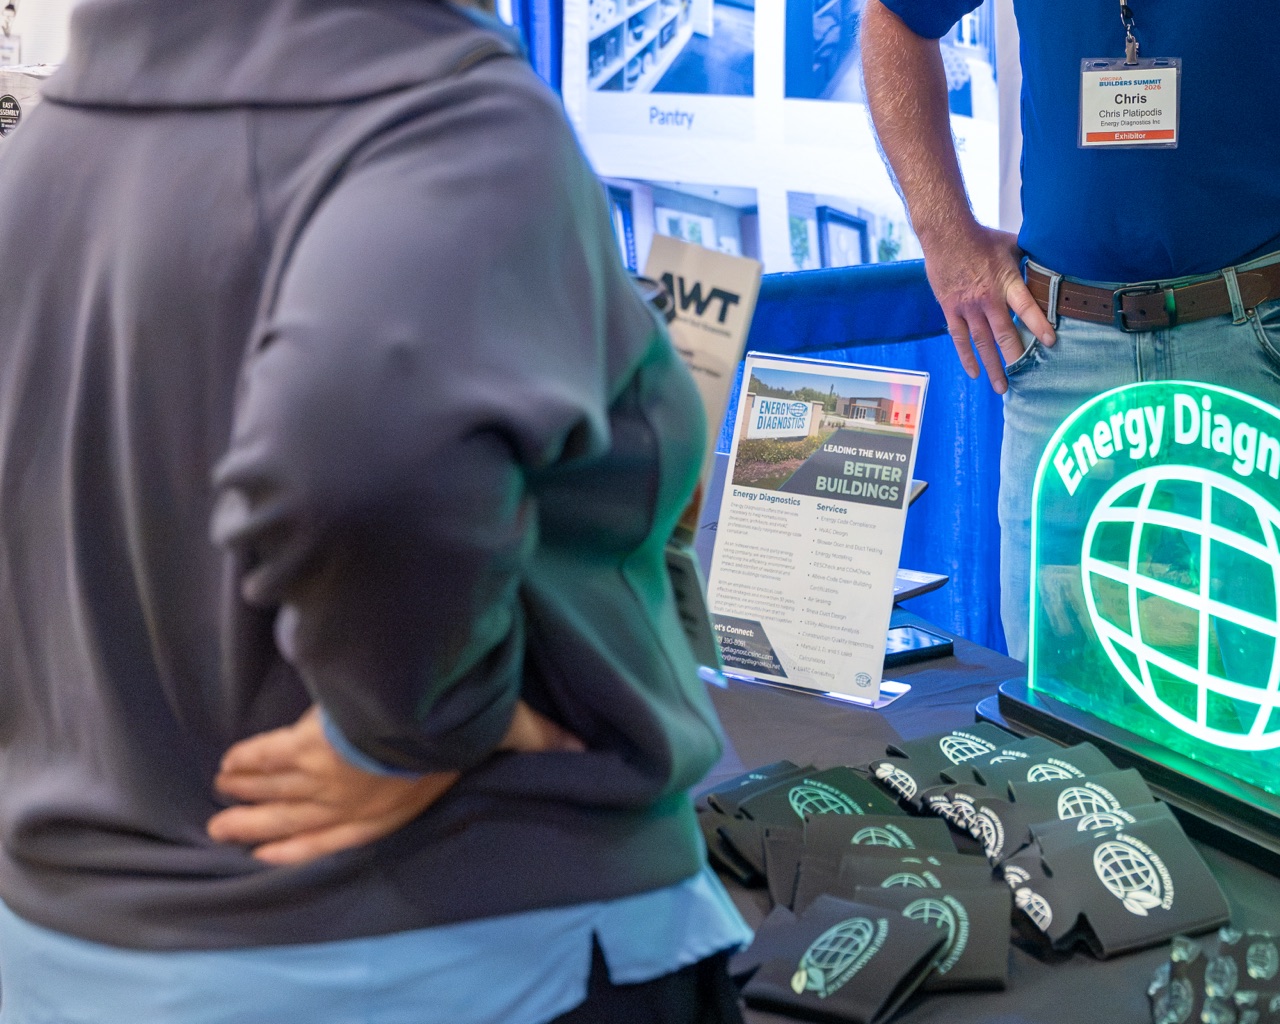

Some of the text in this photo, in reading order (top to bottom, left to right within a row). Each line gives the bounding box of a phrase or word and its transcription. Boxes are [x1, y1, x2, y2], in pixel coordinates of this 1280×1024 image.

[1114, 93, 1147, 104] Chris
[648, 106, 695, 130] Pantry
[1098, 109, 1120, 118] Chris
[1120, 119, 1151, 127] Diagnostics
[1114, 132, 1146, 140] Exhibitor
[759, 400, 790, 415] ENERGY
[757, 415, 806, 430] DIAGNOSTICS
[823, 443, 907, 463] LEADING THE WAY TO
[1053, 404, 1165, 496] Energy
[843, 460, 903, 483] BETTER
[815, 476, 899, 501] BUILDINGS
[732, 489, 801, 506] Energy Diagnostics
[816, 503, 847, 514] Services
